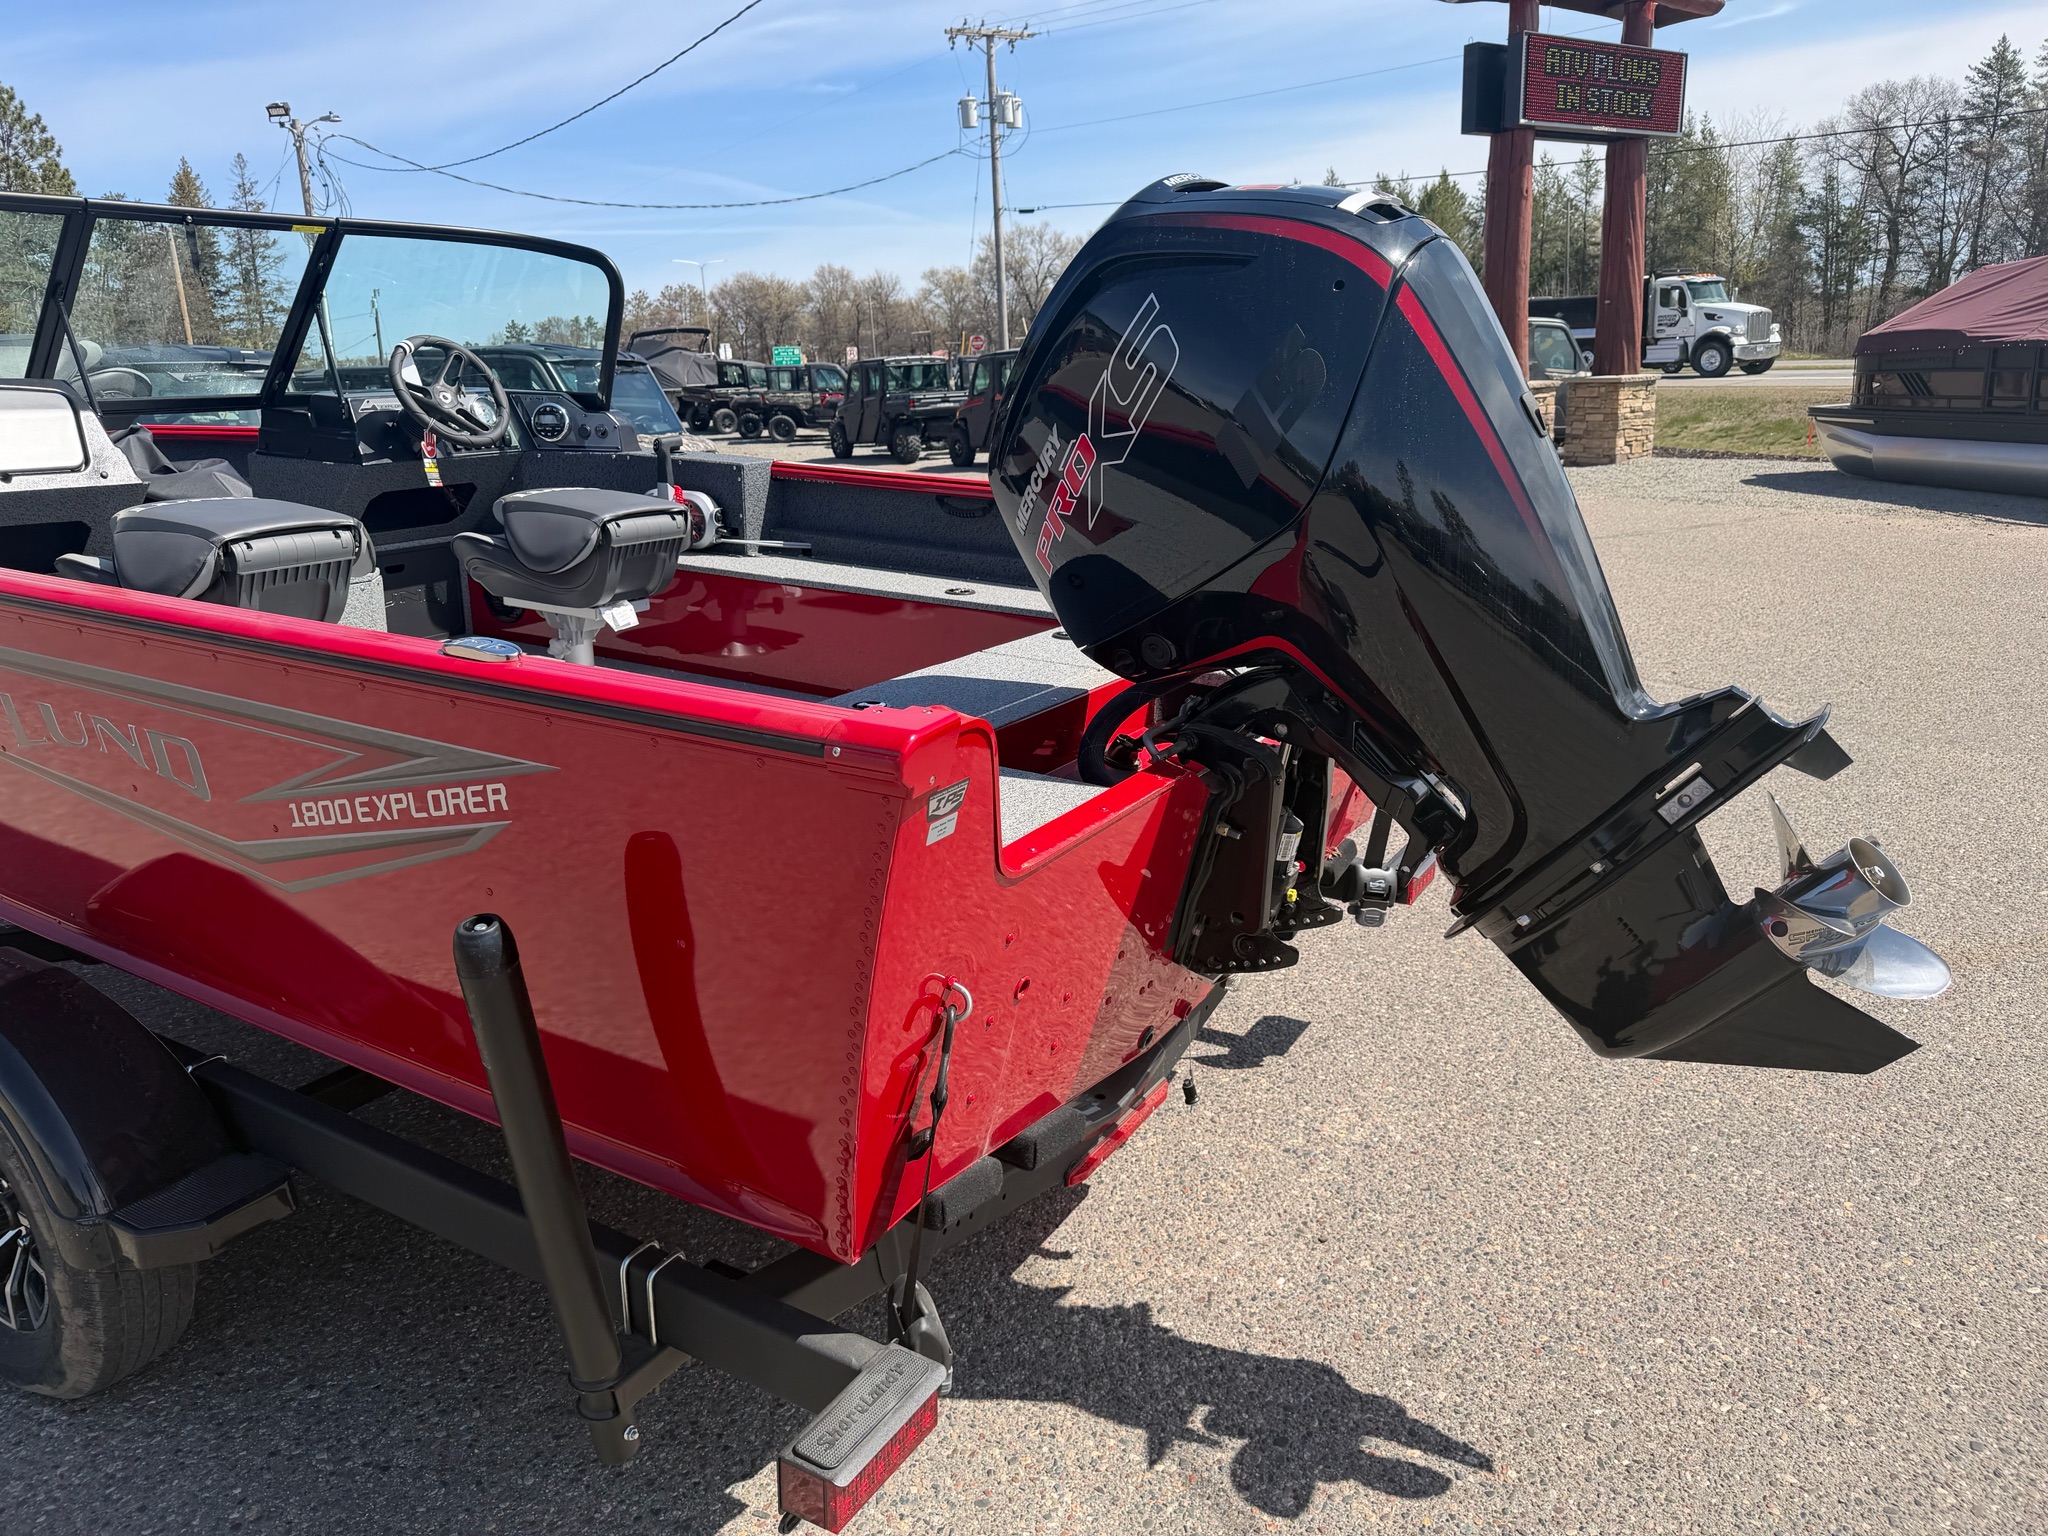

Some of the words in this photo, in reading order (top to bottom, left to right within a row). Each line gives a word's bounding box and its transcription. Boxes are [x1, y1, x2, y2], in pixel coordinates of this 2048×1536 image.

[1545, 47, 1589, 76] ATV
[1593, 53, 1661, 85] PLOWS
[1556, 84, 1581, 110] IN
[1586, 87, 1653, 117] STOCK
[1034, 432, 1098, 578] PRO
[1087, 291, 1180, 532] XS
[1014, 421, 1063, 537] MERCURY
[0, 691, 212, 802] LUND
[288, 799, 353, 829] 1800
[355, 782, 510, 824] EXPLORER
[930, 786, 966, 814] IPS
